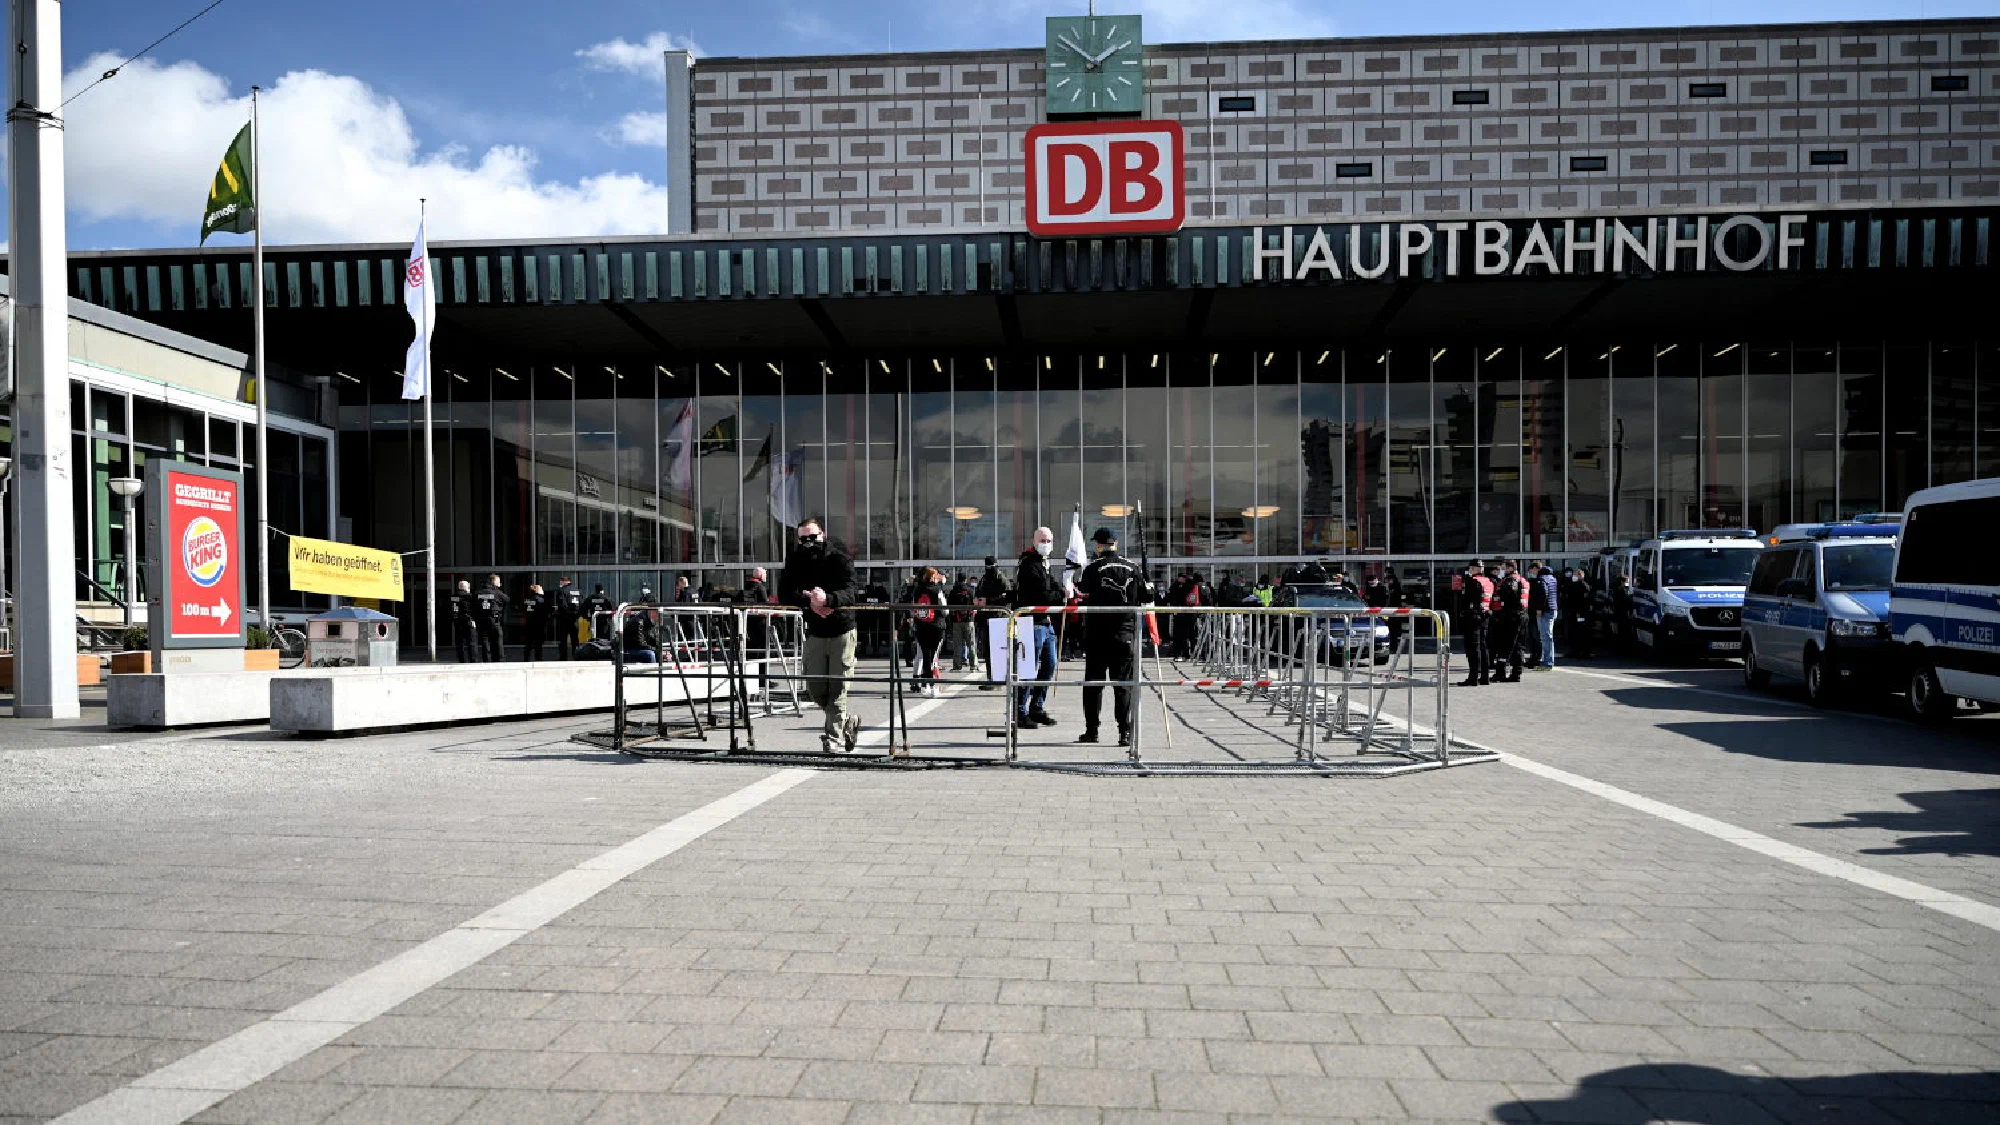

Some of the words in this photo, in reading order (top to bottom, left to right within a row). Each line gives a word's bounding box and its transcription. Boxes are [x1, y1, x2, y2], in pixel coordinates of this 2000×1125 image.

[1047, 140, 1163, 216] DB
[1252, 214, 1808, 280] HAUPTBAHNHOF
[175, 484, 232, 503] GEGRILLT
[188, 532, 221, 552] BURGER
[190, 543, 222, 570] KING
[295, 547, 311, 562] Wir
[312, 550, 342, 567] haben
[1958, 625, 1994, 643] POLIZEI
